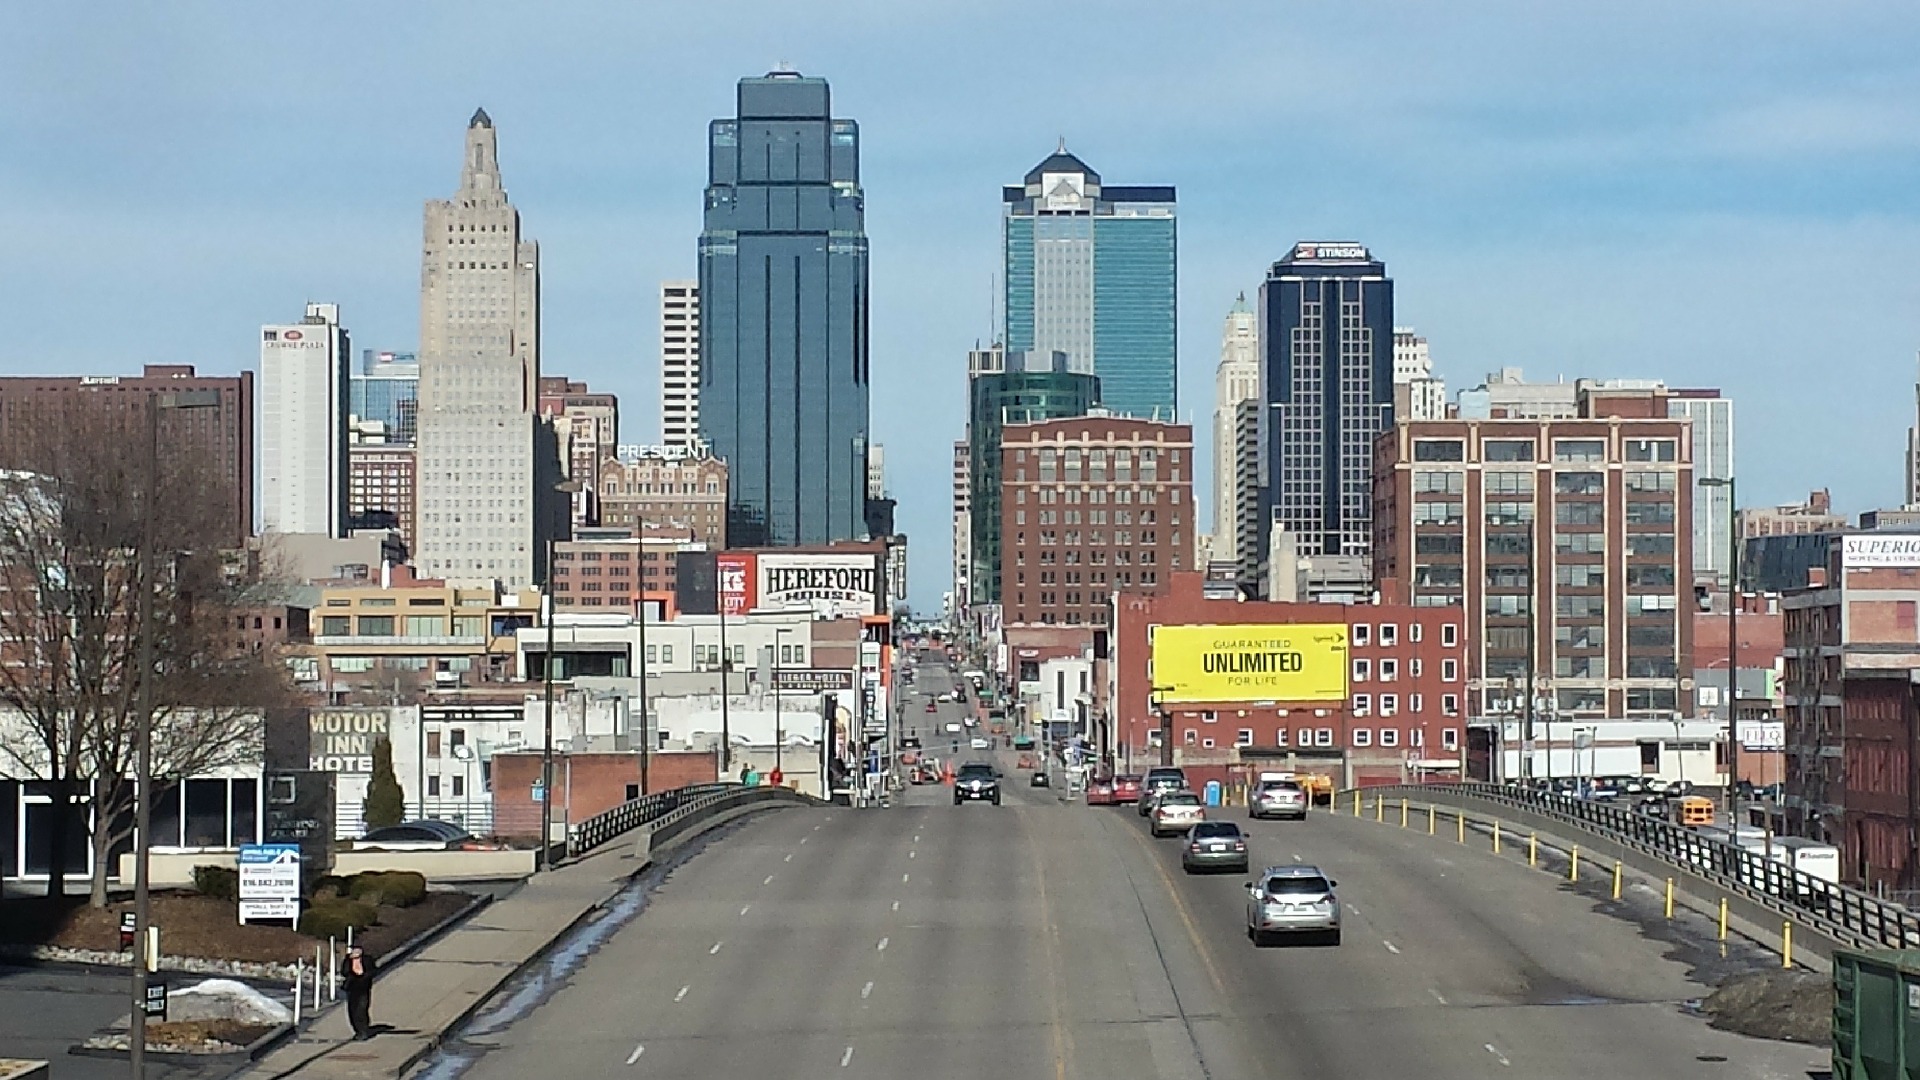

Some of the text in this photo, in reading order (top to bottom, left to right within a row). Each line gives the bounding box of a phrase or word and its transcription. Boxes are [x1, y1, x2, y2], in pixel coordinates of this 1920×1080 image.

[1317, 247, 1365, 258] STINSON
[617, 443, 711, 460] PRESIDENT
[765, 567, 875, 596] HEREFORD
[785, 590, 857, 602] HOUSE
[1213, 640, 1292, 649] GUARANTEED
[1203, 652, 1303, 673] UNLIMITED
[1228, 676, 1278, 686] FOR LIFE
[309, 712, 387, 733] MOTOR
[326, 735, 367, 755] INN
[309, 757, 373, 772] HOTE
